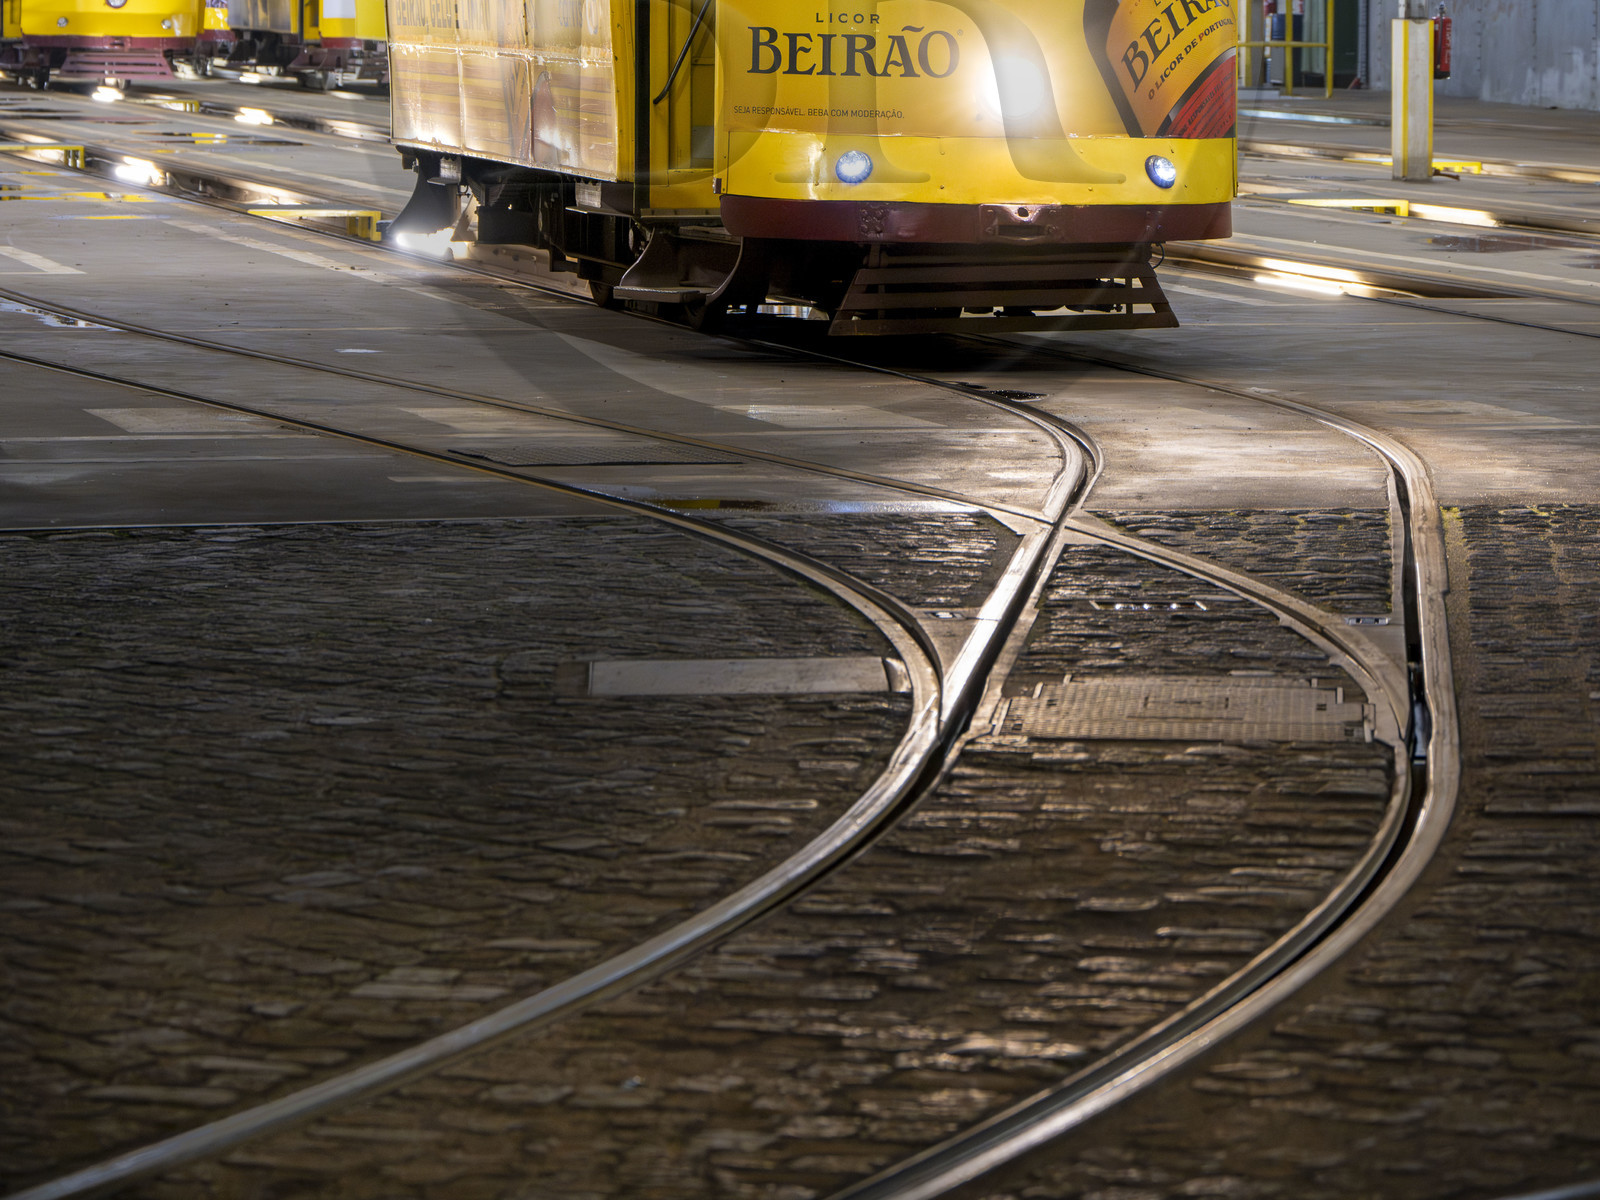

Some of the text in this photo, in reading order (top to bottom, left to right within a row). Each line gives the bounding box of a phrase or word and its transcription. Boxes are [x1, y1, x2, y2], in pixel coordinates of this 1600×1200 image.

[816, 12, 880, 24] LICOR
[747, 25, 960, 79] BEIRÃO
[1148, 17, 1234, 100] O LICOR DE PORTUGAL
[733, 105, 905, 120] SEJA RESPONSÁVEL. BEBA COM MODERAÇÃO.
